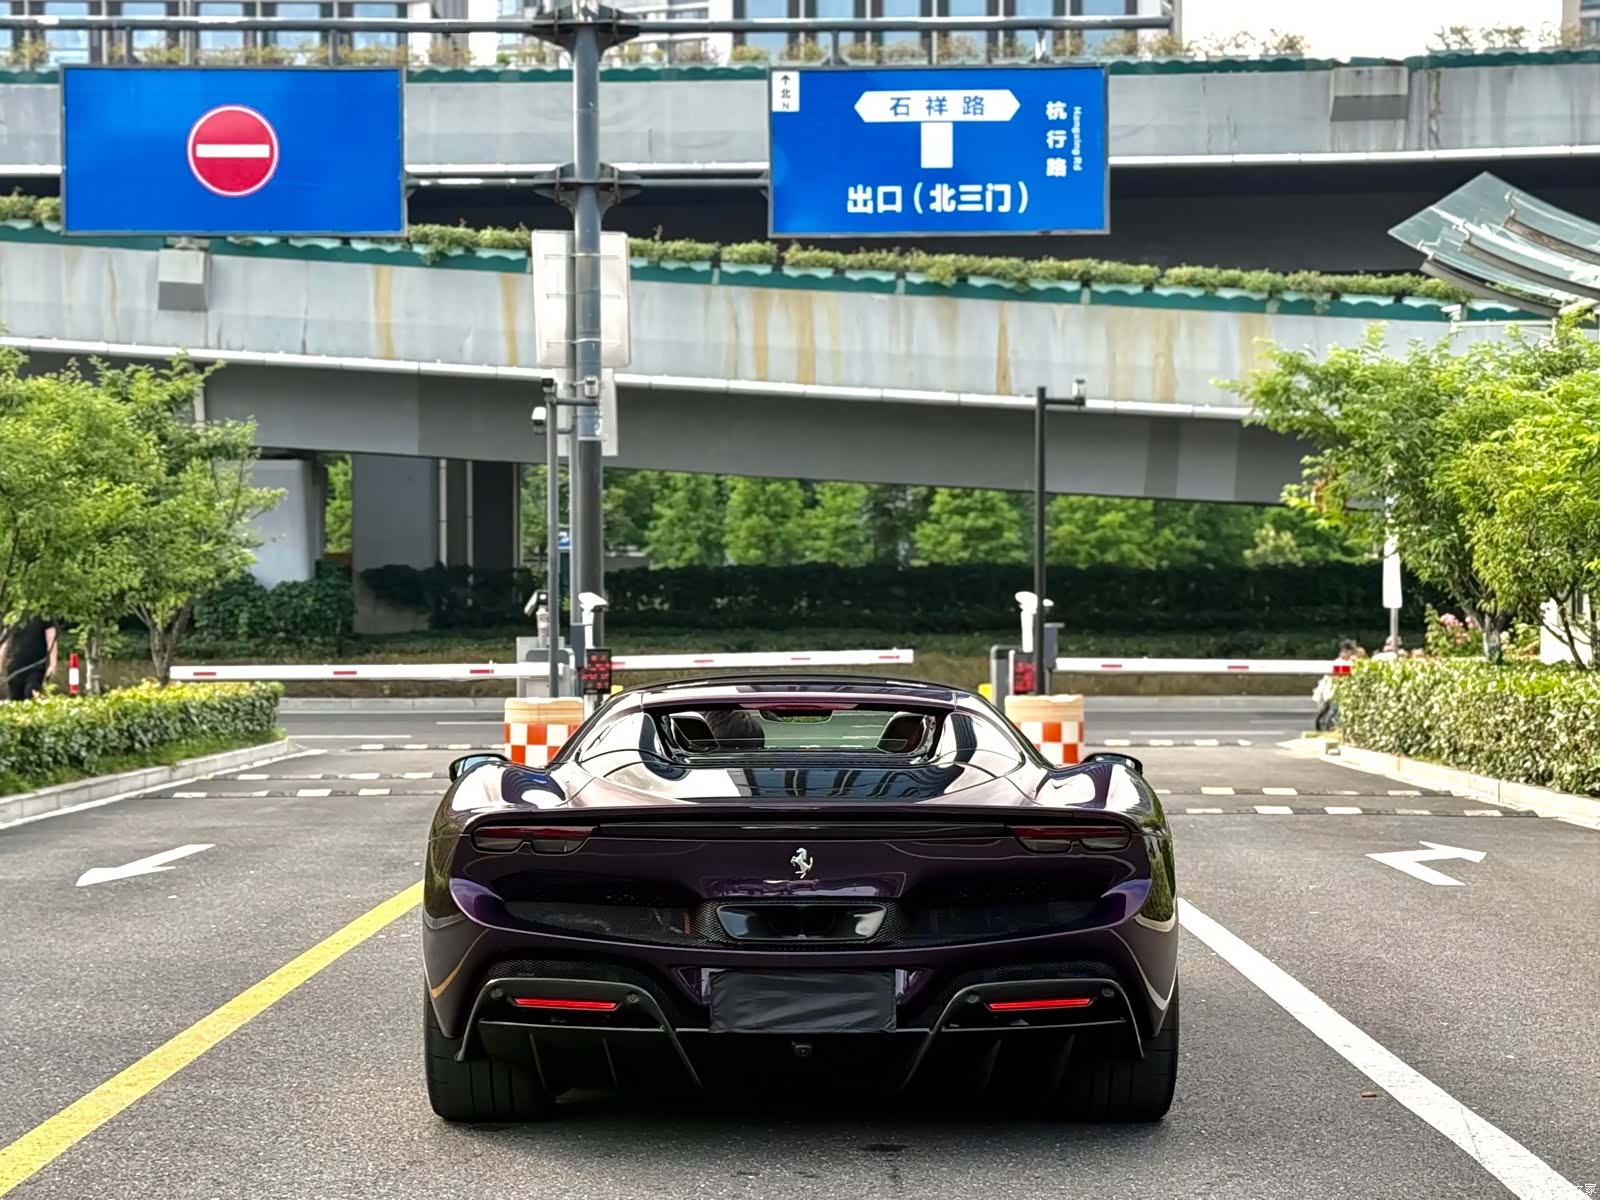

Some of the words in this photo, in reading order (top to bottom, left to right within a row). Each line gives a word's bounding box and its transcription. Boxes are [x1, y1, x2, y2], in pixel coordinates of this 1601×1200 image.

[780, 88, 791, 99] 北
[890, 95, 985, 117] 石祥路
[1046, 101, 1067, 177] 杭行路
[1073, 156, 1083, 171] Rd
